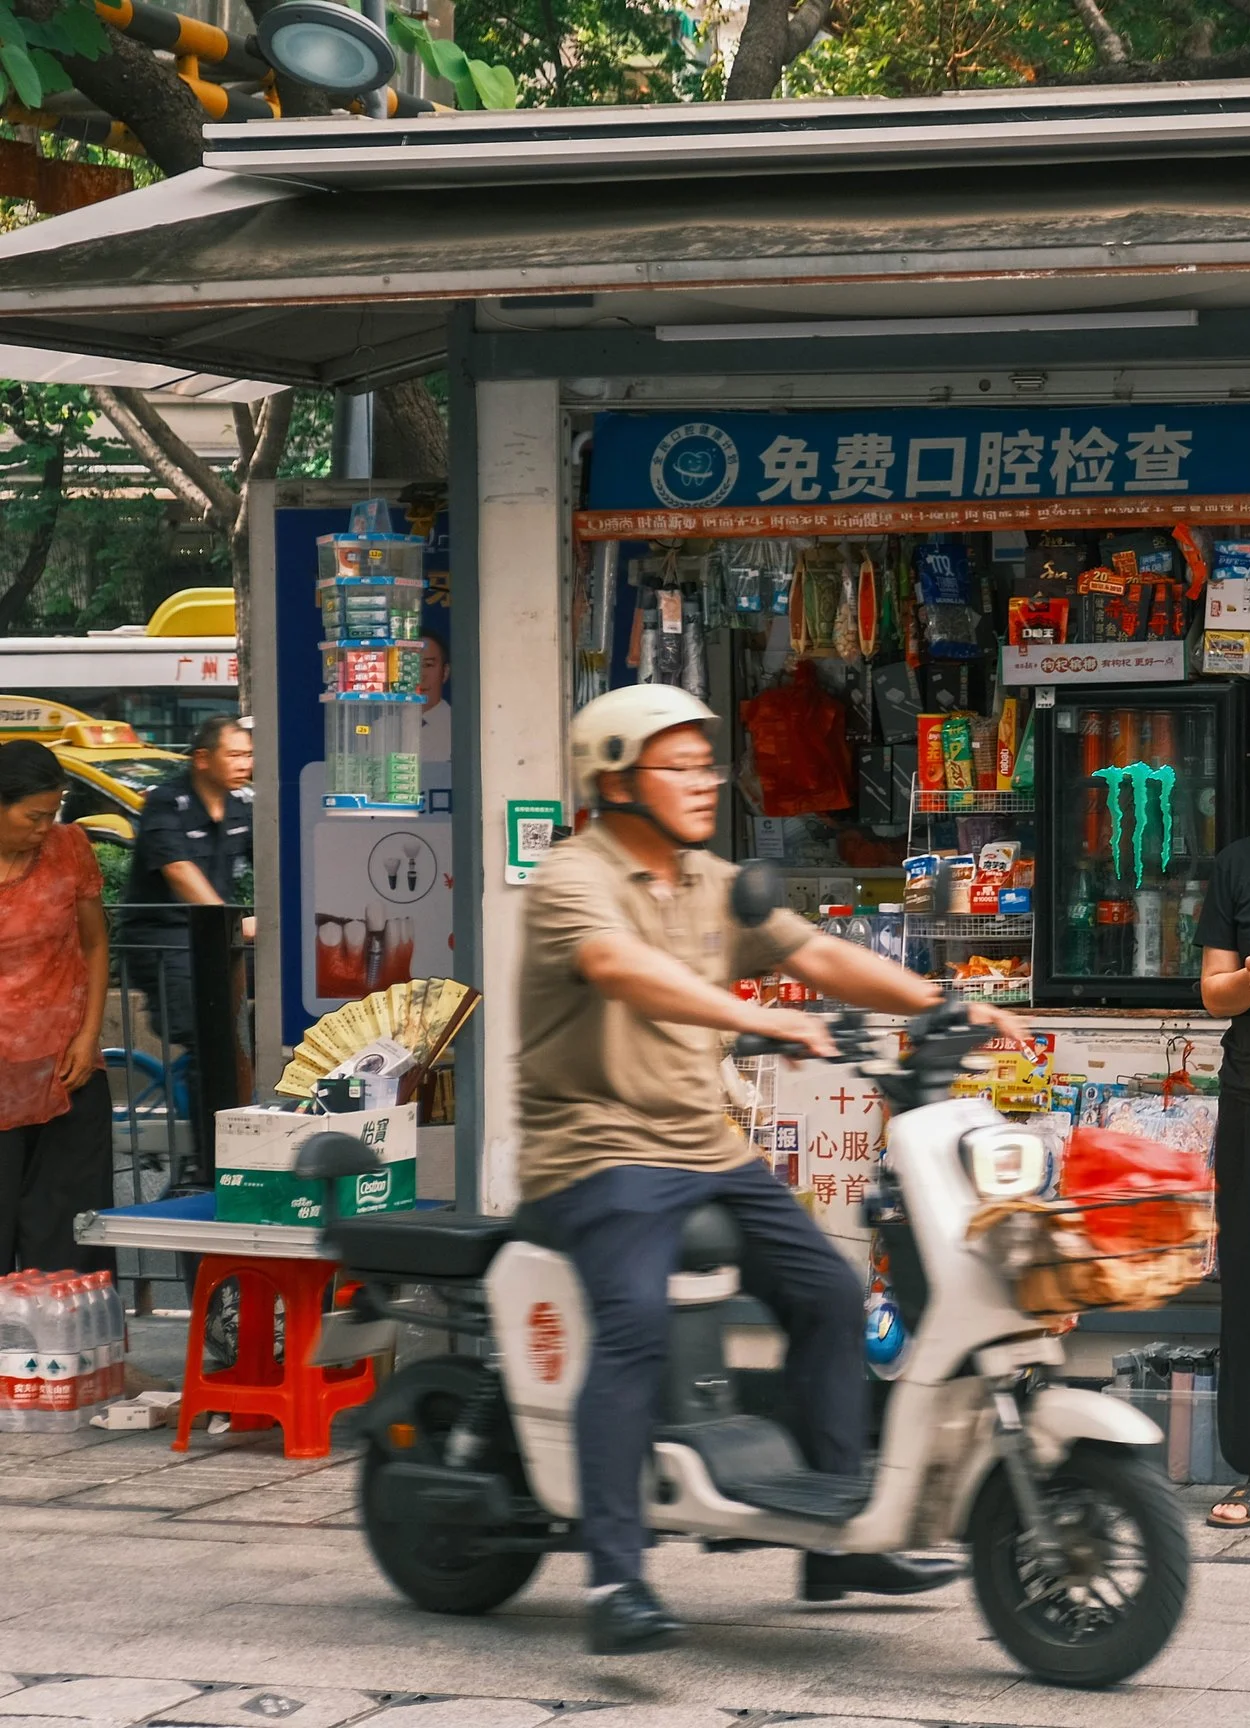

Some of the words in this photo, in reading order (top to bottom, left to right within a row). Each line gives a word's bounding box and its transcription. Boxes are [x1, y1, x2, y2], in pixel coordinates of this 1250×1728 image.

[757, 424, 1193, 501] 免费口腔检查
[1040, 656, 1098, 673] 枸杞槟榔
[1101, 658, 1131, 668] 有枸杞
[1134, 656, 1175, 668] 更好一点
[360, 1179, 387, 1196] Cestbon
[811, 1173, 870, 1206] 辱首
